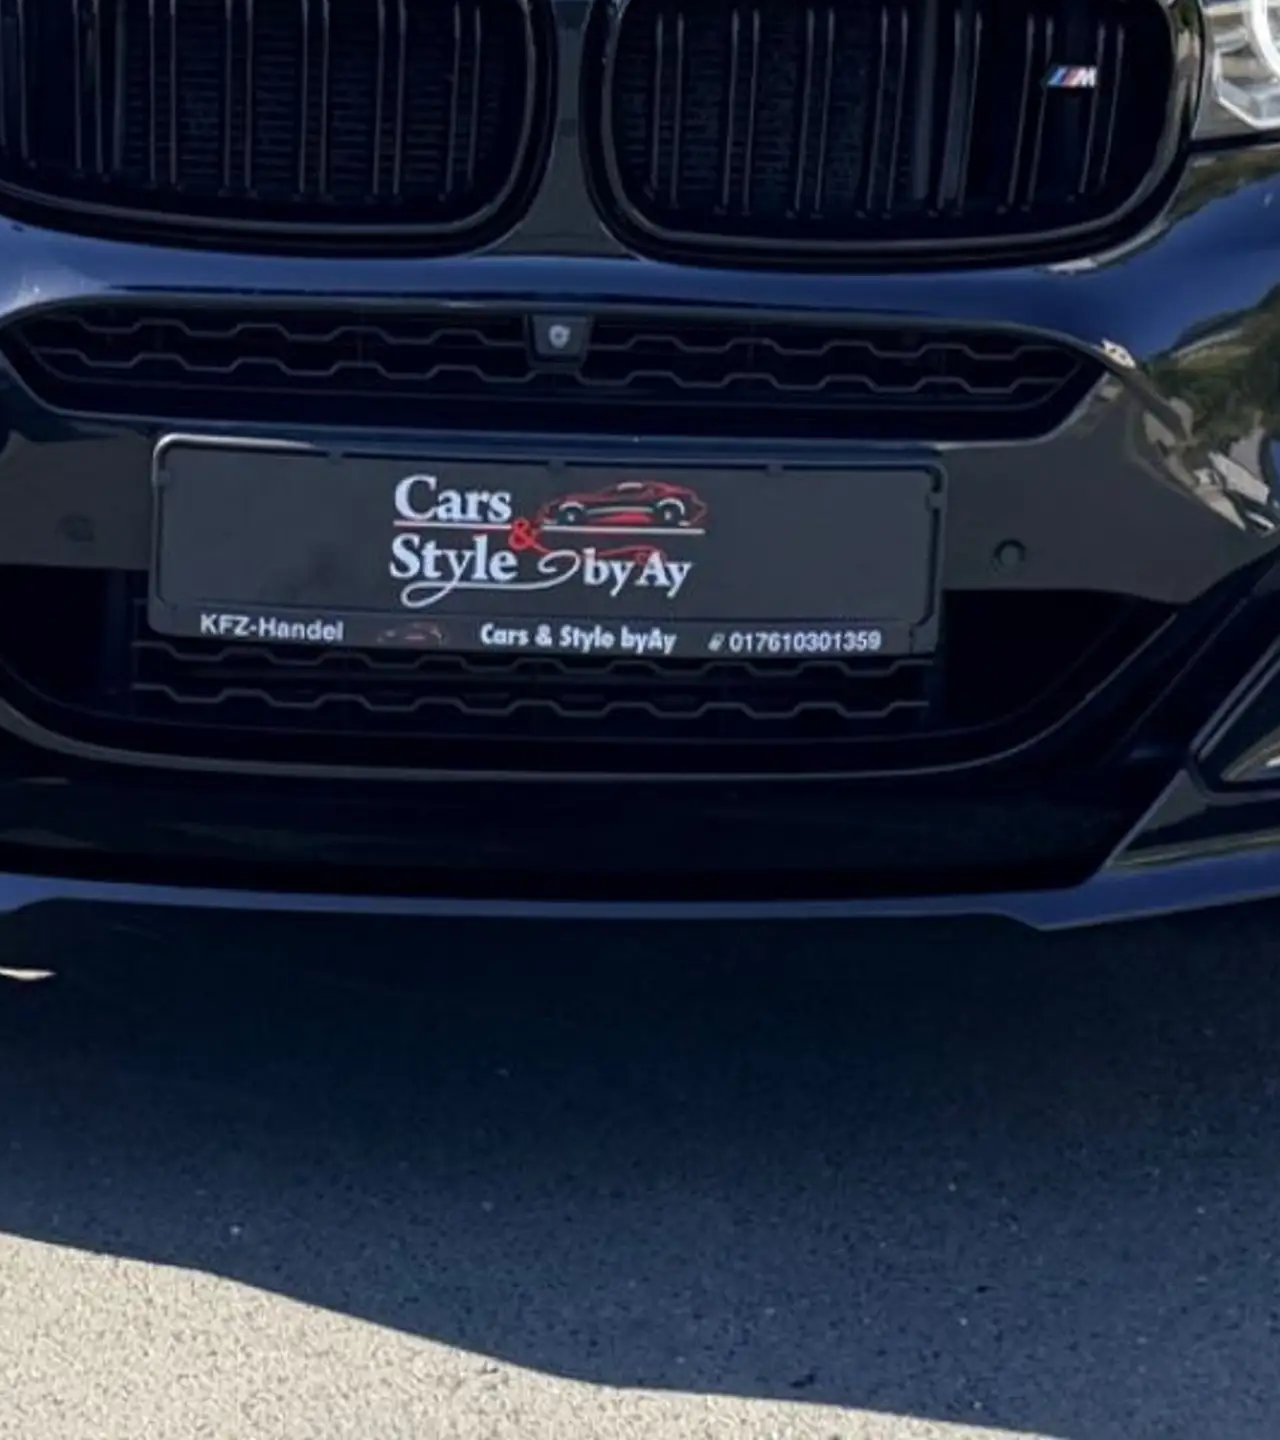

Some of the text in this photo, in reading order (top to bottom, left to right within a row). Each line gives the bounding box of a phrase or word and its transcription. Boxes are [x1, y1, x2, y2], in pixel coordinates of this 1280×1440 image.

[394, 474, 512, 522] Cars
[508, 518, 543, 551] &
[389, 533, 519, 607] Style
[199, 613, 345, 642] KFZ-Handel
[480, 622, 529, 646] Cars
[534, 624, 553, 647] &
[558, 624, 616, 654] Style
[728, 629, 882, 653] 017610301359
